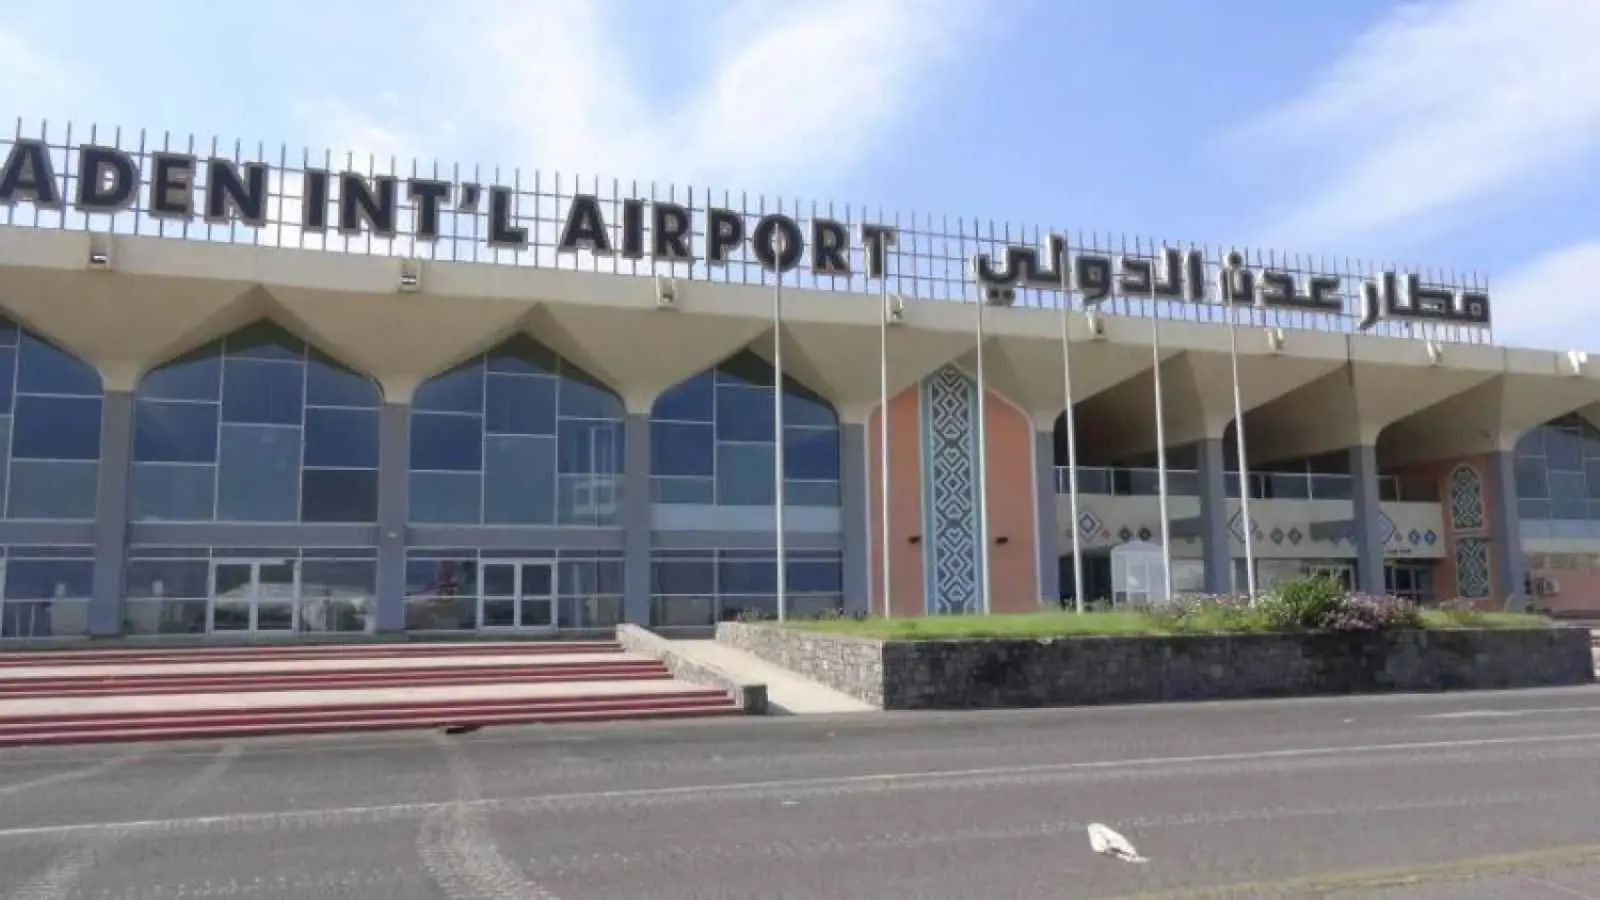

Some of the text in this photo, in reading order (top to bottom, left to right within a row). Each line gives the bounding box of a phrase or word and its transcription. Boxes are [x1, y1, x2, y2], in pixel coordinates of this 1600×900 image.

[0, 138, 897, 279] ADEN INT'L AIRPORT
[974, 233, 1492, 330] مطار عدن الدولي
